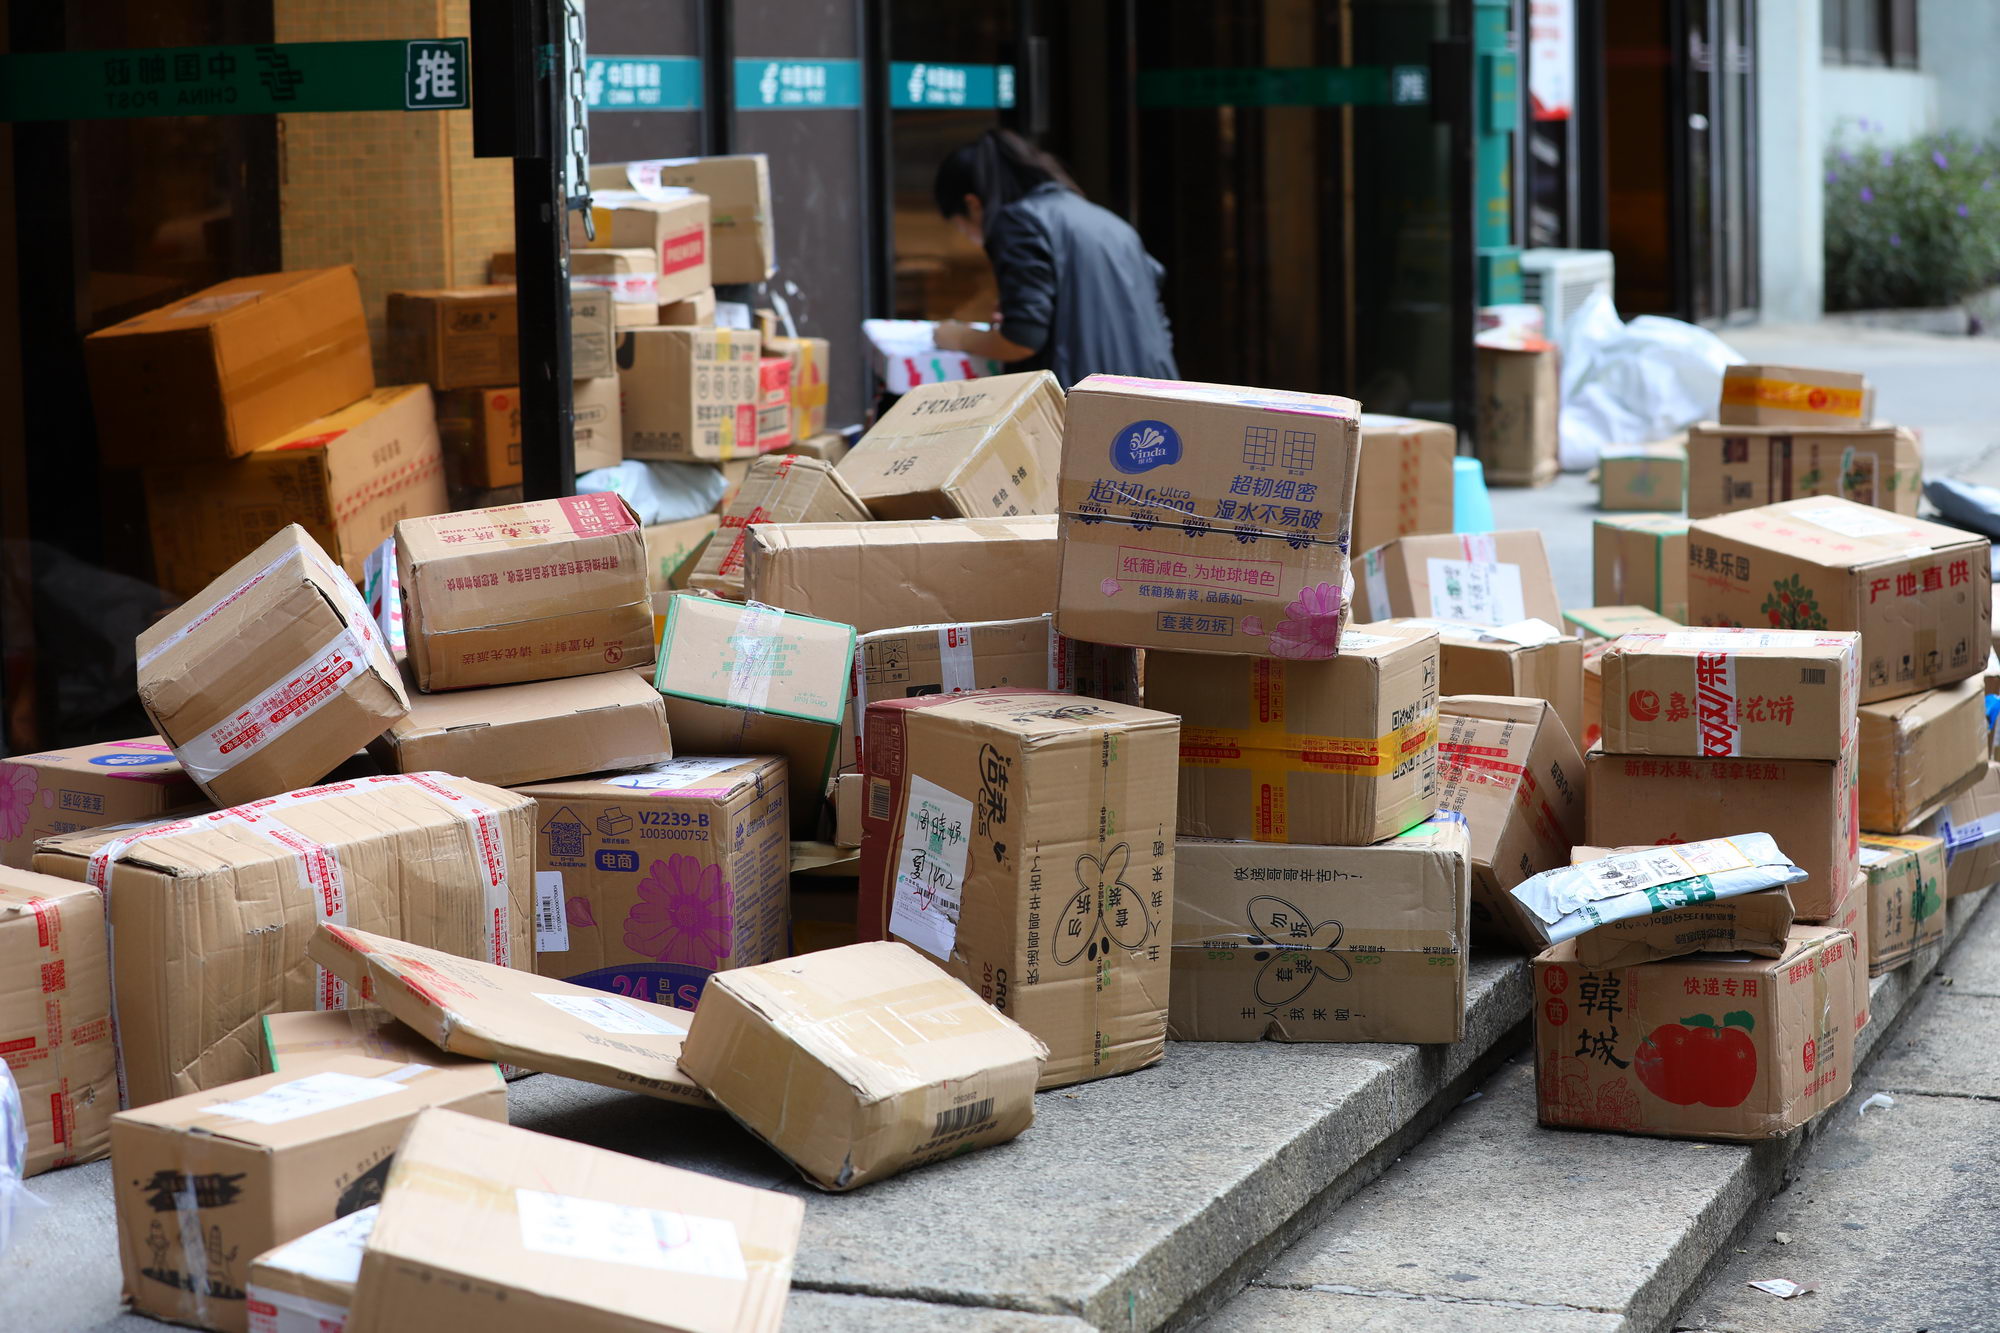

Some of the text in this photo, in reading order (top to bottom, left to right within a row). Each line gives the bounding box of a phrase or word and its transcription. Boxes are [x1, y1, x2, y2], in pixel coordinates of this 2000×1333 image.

[415, 49, 456, 99] 推
[1129, 446, 1167, 461] Vinda
[1011, 466, 1028, 487] 合格
[1229, 475, 1318, 503] 超韧细密
[1088, 479, 1143, 507] 超韧
[1141, 488, 1195, 514] Strong
[1160, 486, 1192, 499] Ultra
[1214, 499, 1323, 530] 湿水不易破
[1123, 556, 1276, 587] 纸箱减色，为地球增色
[1690, 544, 1750, 582] 鲜果乐园
[1870, 559, 1970, 604] 产地直供
[1138, 584, 1255, 606] 纸箱换新装，品质如一
[1162, 614, 1229, 633] 套装勿拆
[460, 637, 595, 666] 内置鲜果 请优先派送
[61, 793, 102, 812] 套装勿拆
[979, 745, 1009, 835] 洁柔
[638, 811, 710, 828] V2239-B
[979, 788, 987, 837] C&S
[640, 828, 709, 842] 1003000752
[601, 853, 633, 870] 电商
[1233, 867, 1363, 883] 快递哥哥辛苦了！
[1068, 894, 1091, 938] 勿拆
[1109, 887, 1129, 928] 套装
[1270, 912, 1308, 938] 勿拆
[981, 961, 992, 999] 20包
[1276, 959, 1313, 983] 套装
[612, 975, 648, 1000] 24
[659, 978, 671, 991] 包
[1547, 970, 1565, 1021] 陕西
[1683, 975, 1759, 998] 快递专用
[1575, 971, 1630, 1070] 韓城
